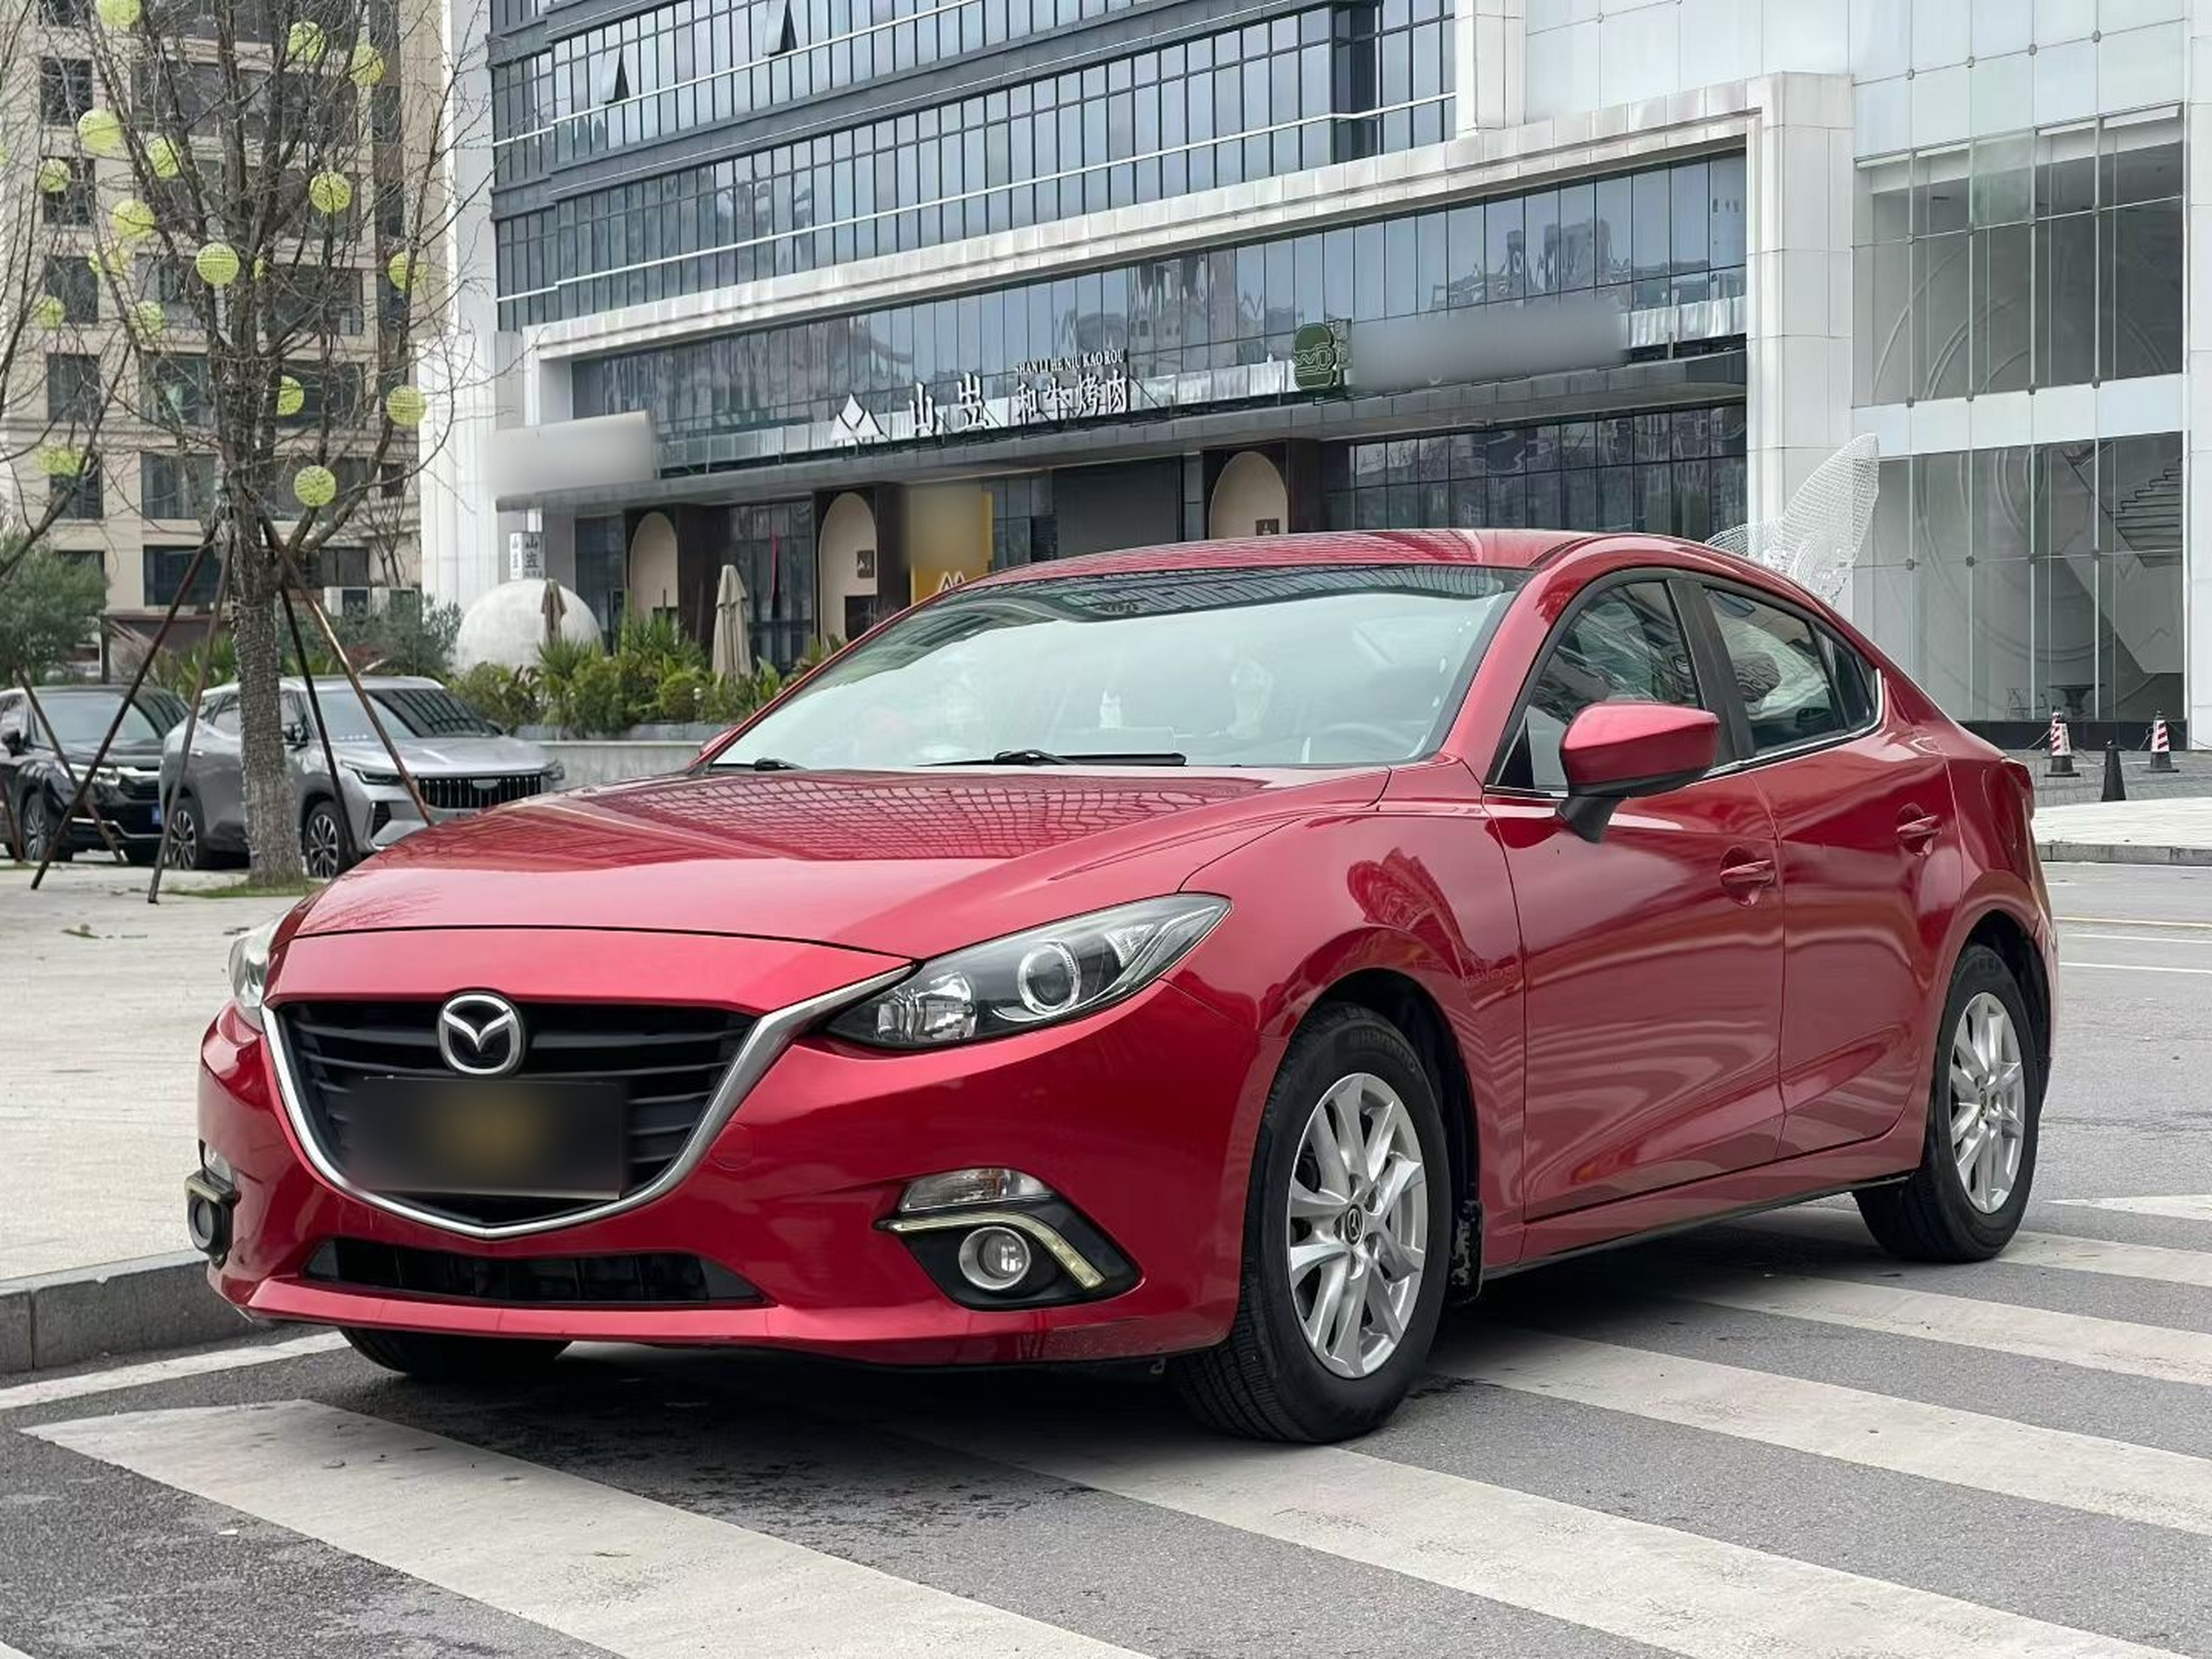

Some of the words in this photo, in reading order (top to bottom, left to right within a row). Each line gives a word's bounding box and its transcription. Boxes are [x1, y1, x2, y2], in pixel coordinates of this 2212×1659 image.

[1065, 354, 1081, 370] NIU
[1083, 351, 1103, 367] KAO
[1104, 348, 1124, 365] ROU
[1017, 369, 1127, 425] 和牛烤肉
